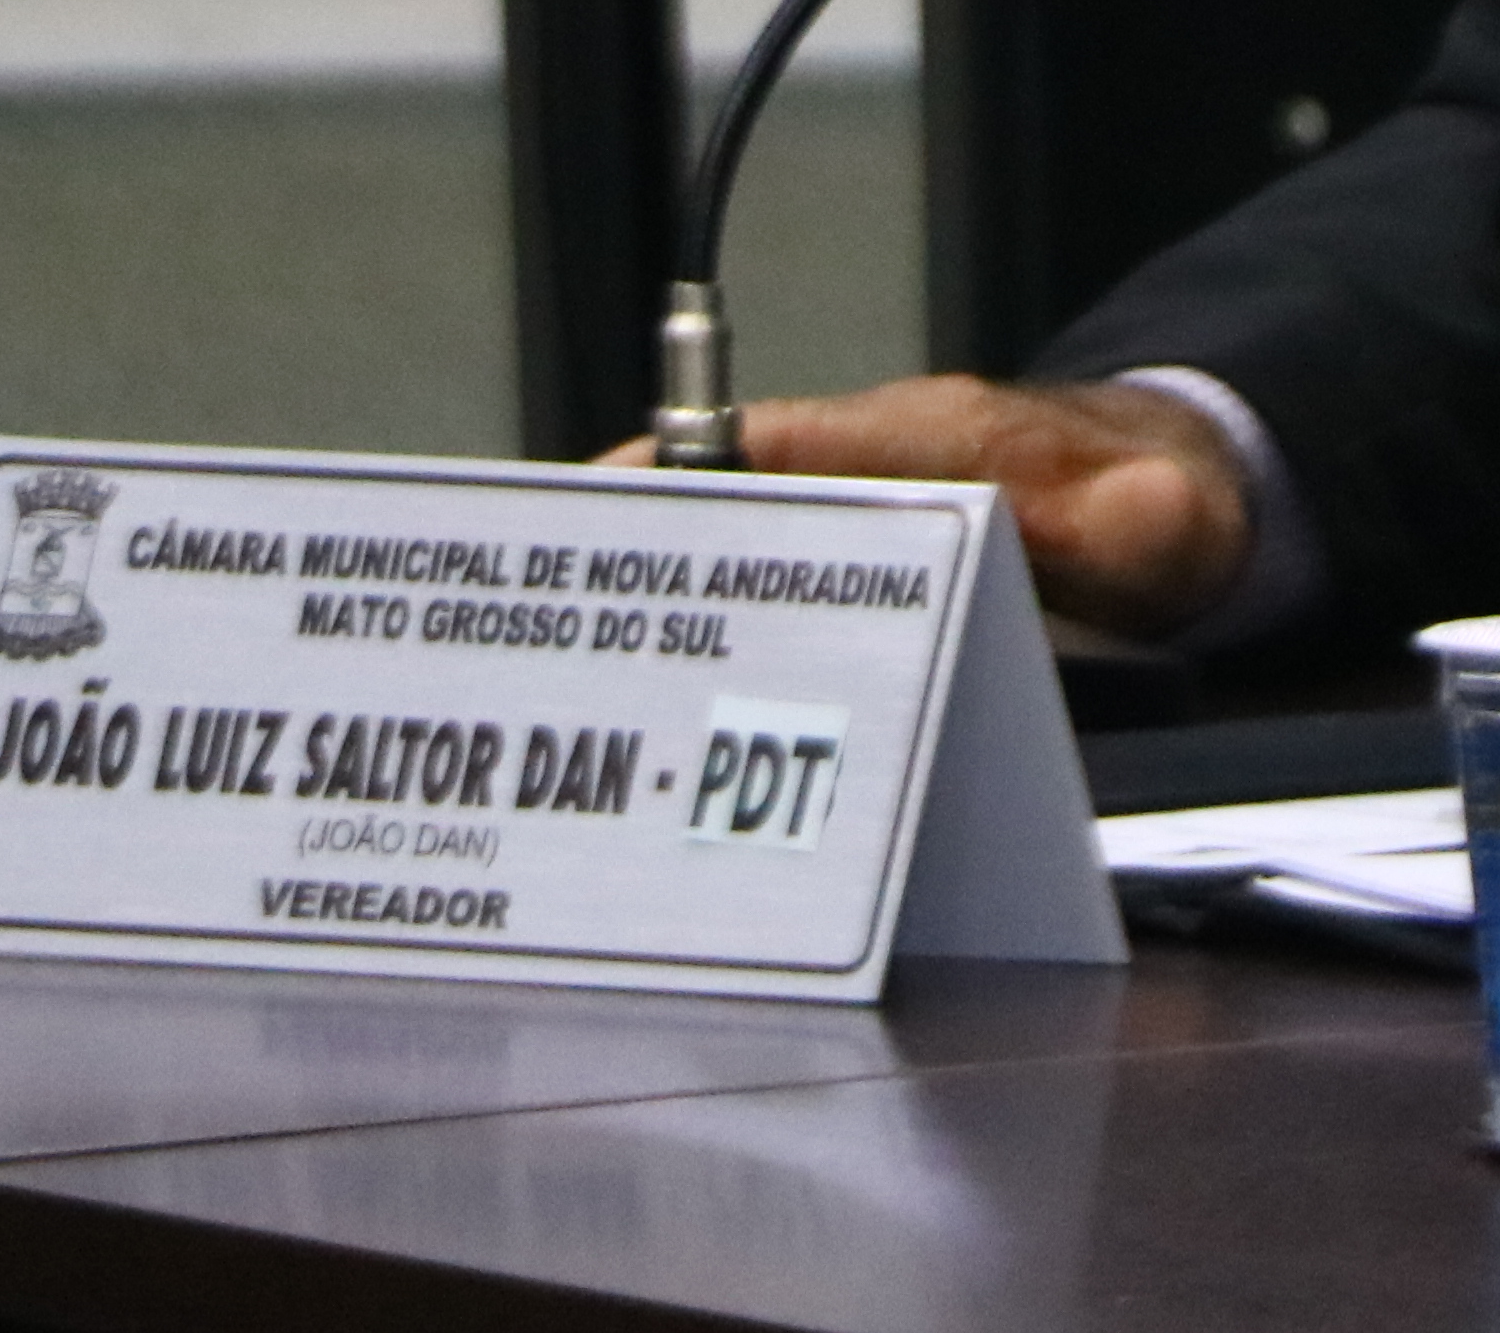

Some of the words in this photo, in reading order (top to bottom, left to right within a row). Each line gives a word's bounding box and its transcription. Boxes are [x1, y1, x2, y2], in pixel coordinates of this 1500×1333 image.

[127, 518, 287, 573] CÂMARA
[300, 534, 510, 586] MUNICIPAL
[523, 544, 577, 589] DE
[587, 548, 691, 597] NOVA
[703, 555, 930, 609] ANDRADINA
[299, 592, 410, 639] MATO
[422, 598, 581, 648] GROSSO
[593, 608, 648, 652] DO
[658, 613, 731, 658] SUL
[154, 705, 291, 795] LUIZ
[295, 712, 504, 806] SALTOR
[516, 724, 645, 814] DAN
[689, 729, 839, 837] PDT
[299, 814, 406, 857] (JOÃO
[414, 823, 501, 867] DAN)
[261, 877, 511, 929] VEREADOR
